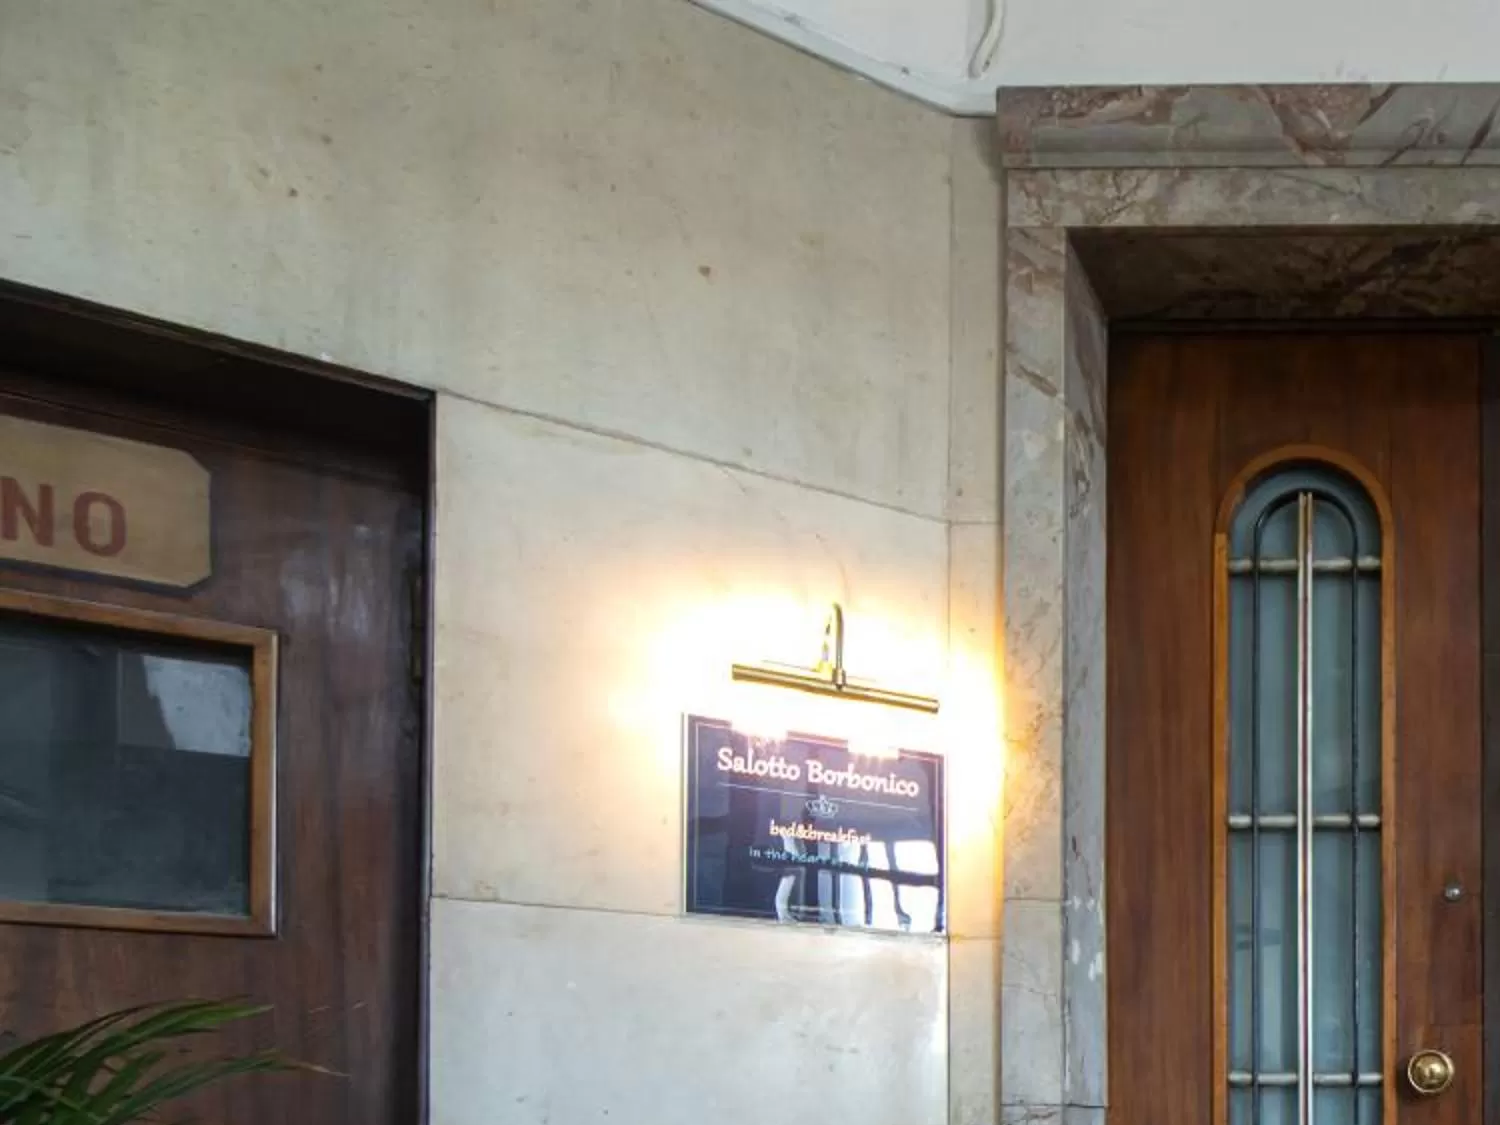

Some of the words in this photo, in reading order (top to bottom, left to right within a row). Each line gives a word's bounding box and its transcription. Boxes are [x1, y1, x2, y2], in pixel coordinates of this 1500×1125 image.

[0, 475, 127, 558] NO
[716, 747, 801, 782] Salotto
[804, 758, 920, 797] Borbonico
